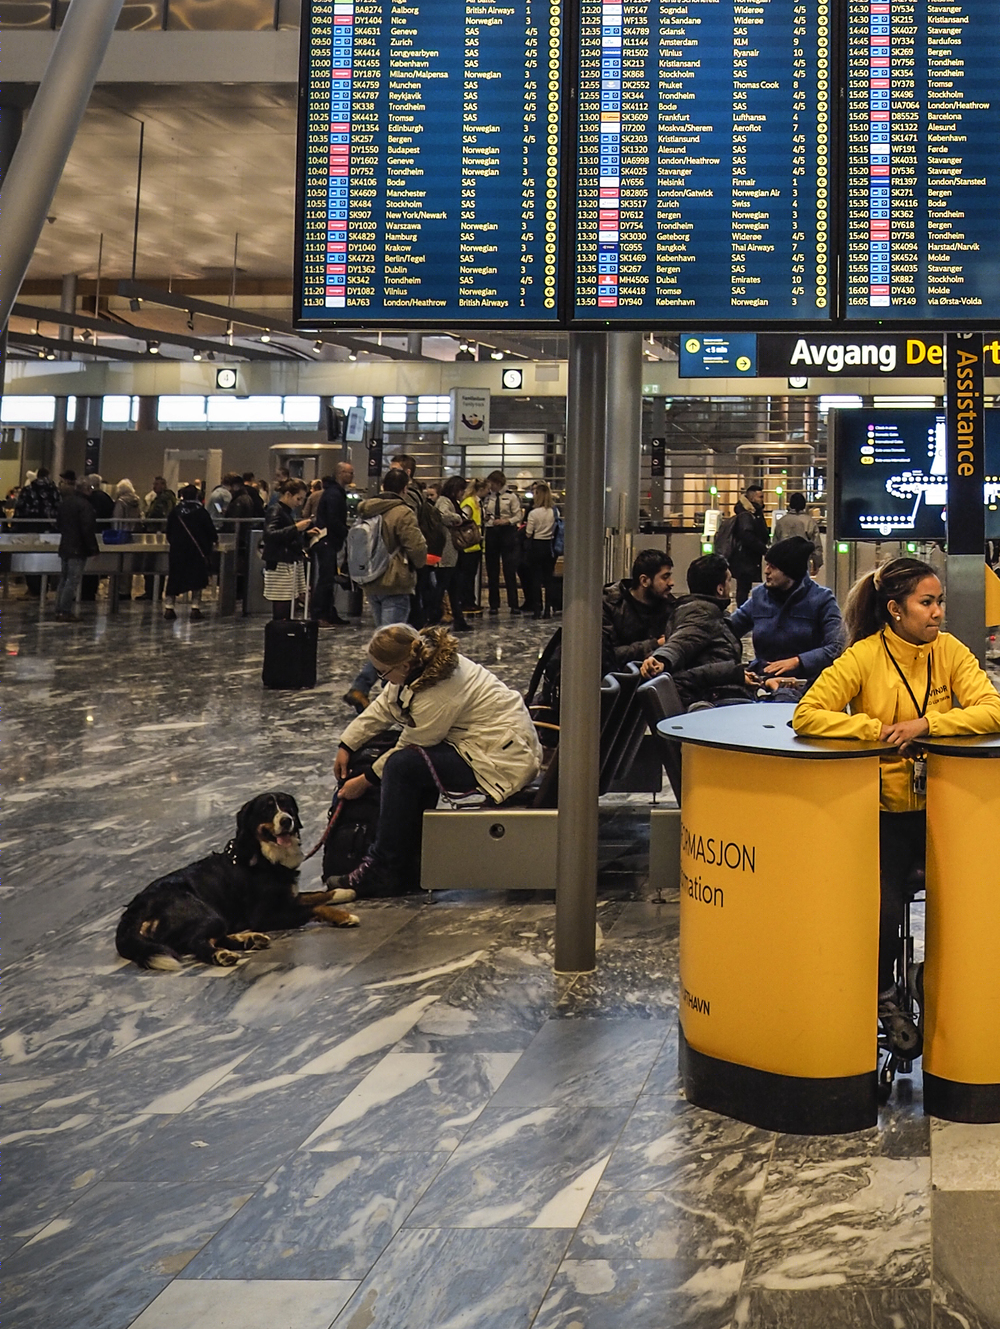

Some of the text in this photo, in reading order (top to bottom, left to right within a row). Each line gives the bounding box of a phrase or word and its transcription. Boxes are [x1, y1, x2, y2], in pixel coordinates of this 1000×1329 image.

[581, 6, 601, 14] 12:20
[659, 5, 688, 16] Sogndal
[734, 5, 764, 14] Widerøe
[793, 5, 806, 15] 4/5
[849, 37, 869, 46] 14:45
[927, 36, 962, 45] Bardufoss
[311, 59, 331, 68] 10:00
[390, 59, 429, 68] København
[464, 59, 479, 68] SAS
[524, 59, 538, 69] 4/5
[579, 156, 599, 165] 13:10
[658, 156, 720, 165] London/Heathrow
[732, 156, 747, 165] SAS
[792, 156, 805, 165] 4/5
[848, 177, 869, 186] 15:25
[928, 176, 986, 186] London/Stansted
[304, 265, 325, 274] 11:15
[384, 265, 408, 274] Dublin
[460, 265, 498, 276] Norwegian
[520, 265, 526, 274] 3
[576, 286, 597, 295] 13:50
[656, 286, 682, 295] Tromsø
[731, 286, 746, 295] SAS
[791, 286, 805, 295] 4/5
[848, 297, 868, 306] 16:05
[928, 297, 939, 305] via
[790, 338, 897, 372] Avgang
[956, 349, 980, 477] Assistance
